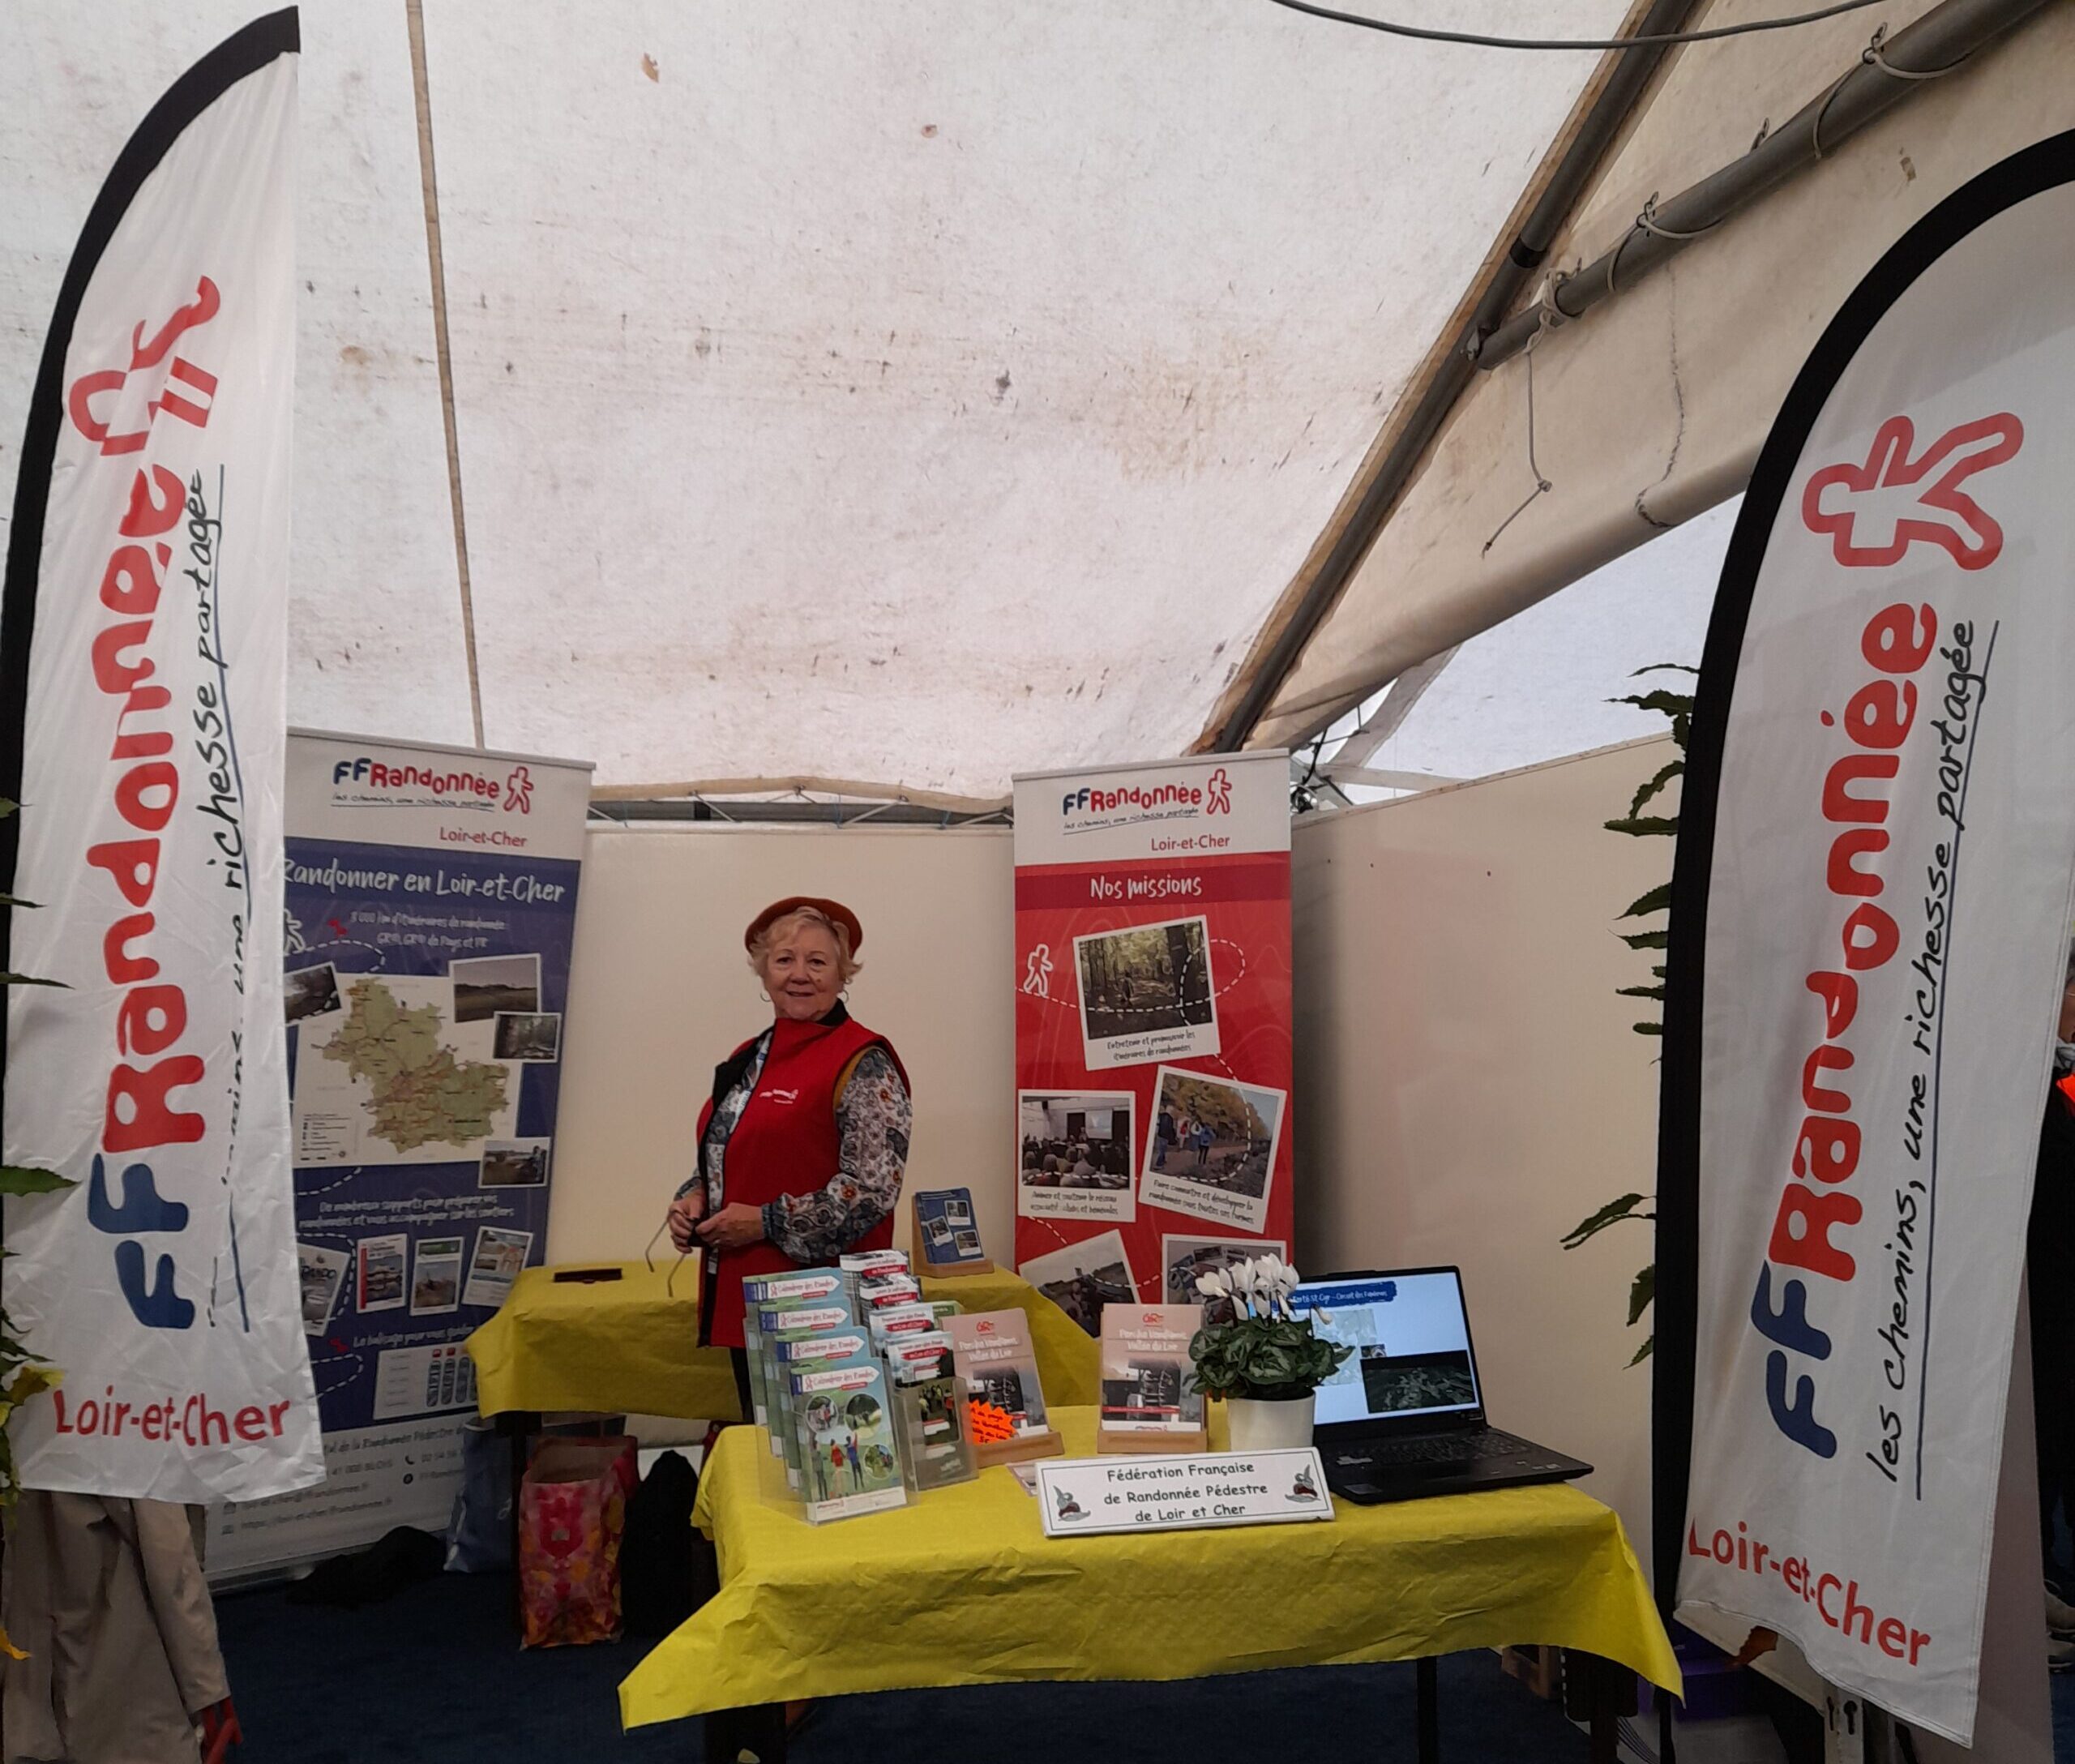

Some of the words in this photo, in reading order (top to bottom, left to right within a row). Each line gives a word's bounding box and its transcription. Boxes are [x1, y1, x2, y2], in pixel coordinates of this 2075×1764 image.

[1930, 620, 1987, 831] partagée
[197, 681, 244, 889] richesse
[333, 757, 499, 799] FFRandonnée
[1063, 780, 1202, 816] FFRandonnée
[439, 826, 527, 848] Loir-et-Cher
[1151, 834, 1230, 852] Loir-et-Cher
[404, 874, 430, 893] en
[436, 870, 565, 904] Loir-et-Cher
[1090, 875, 1123, 900] Nos
[1127, 872, 1202, 900] missions
[1904, 841, 1953, 1055] richesse
[1905, 1073, 1928, 1161] une
[1877, 1178, 1927, 1391] chemins,
[53, 1385, 289, 1446] Loir-et-Cher
[1866, 1404, 1903, 1483] les
[1104, 1492, 1122, 1505] de
[1127, 1485, 1201, 1503] Randonnée
[1206, 1482, 1269, 1497] Pédestre
[1107, 1466, 1183, 1483] Fédération
[1187, 1462, 1256, 1478] Française
[1135, 1509, 1153, 1522] de
[1158, 1505, 1186, 1521] Loir
[1192, 1505, 1208, 1518] et
[1213, 1503, 1247, 1516] Cher
[1688, 1514, 1932, 1668] Loir-et-Cher
